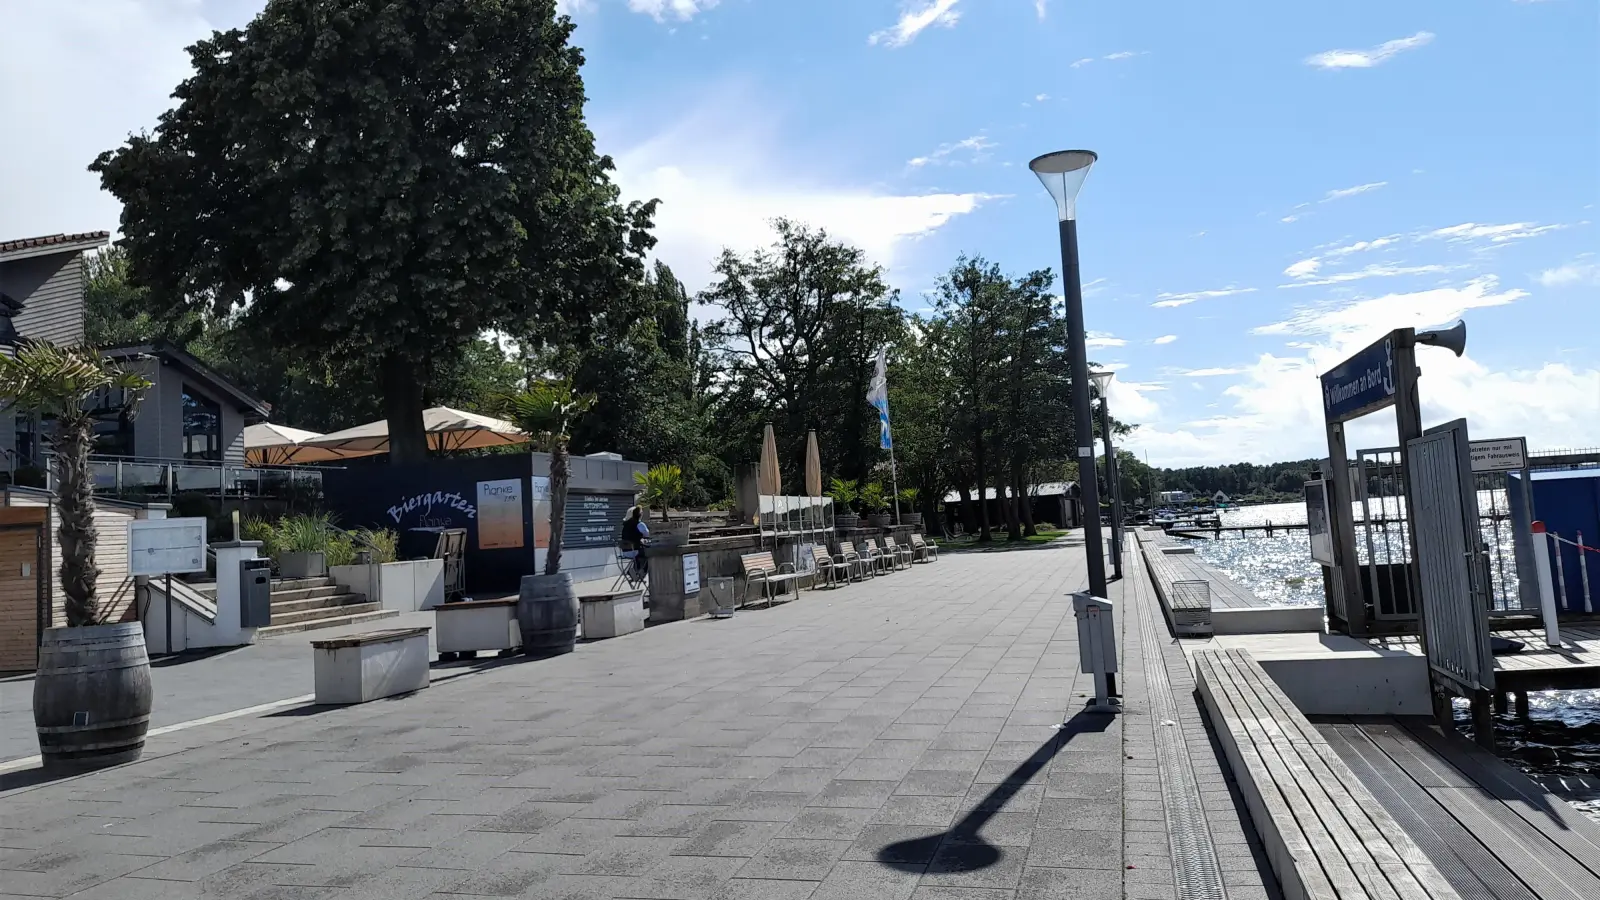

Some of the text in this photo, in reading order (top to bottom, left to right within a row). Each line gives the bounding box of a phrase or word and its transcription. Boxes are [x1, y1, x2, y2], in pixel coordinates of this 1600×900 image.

[1330, 361, 1382, 405] Willkommen an Bord
[1487, 452, 1520, 460] Fahrausweis
[387, 490, 477, 524] Biergarten
